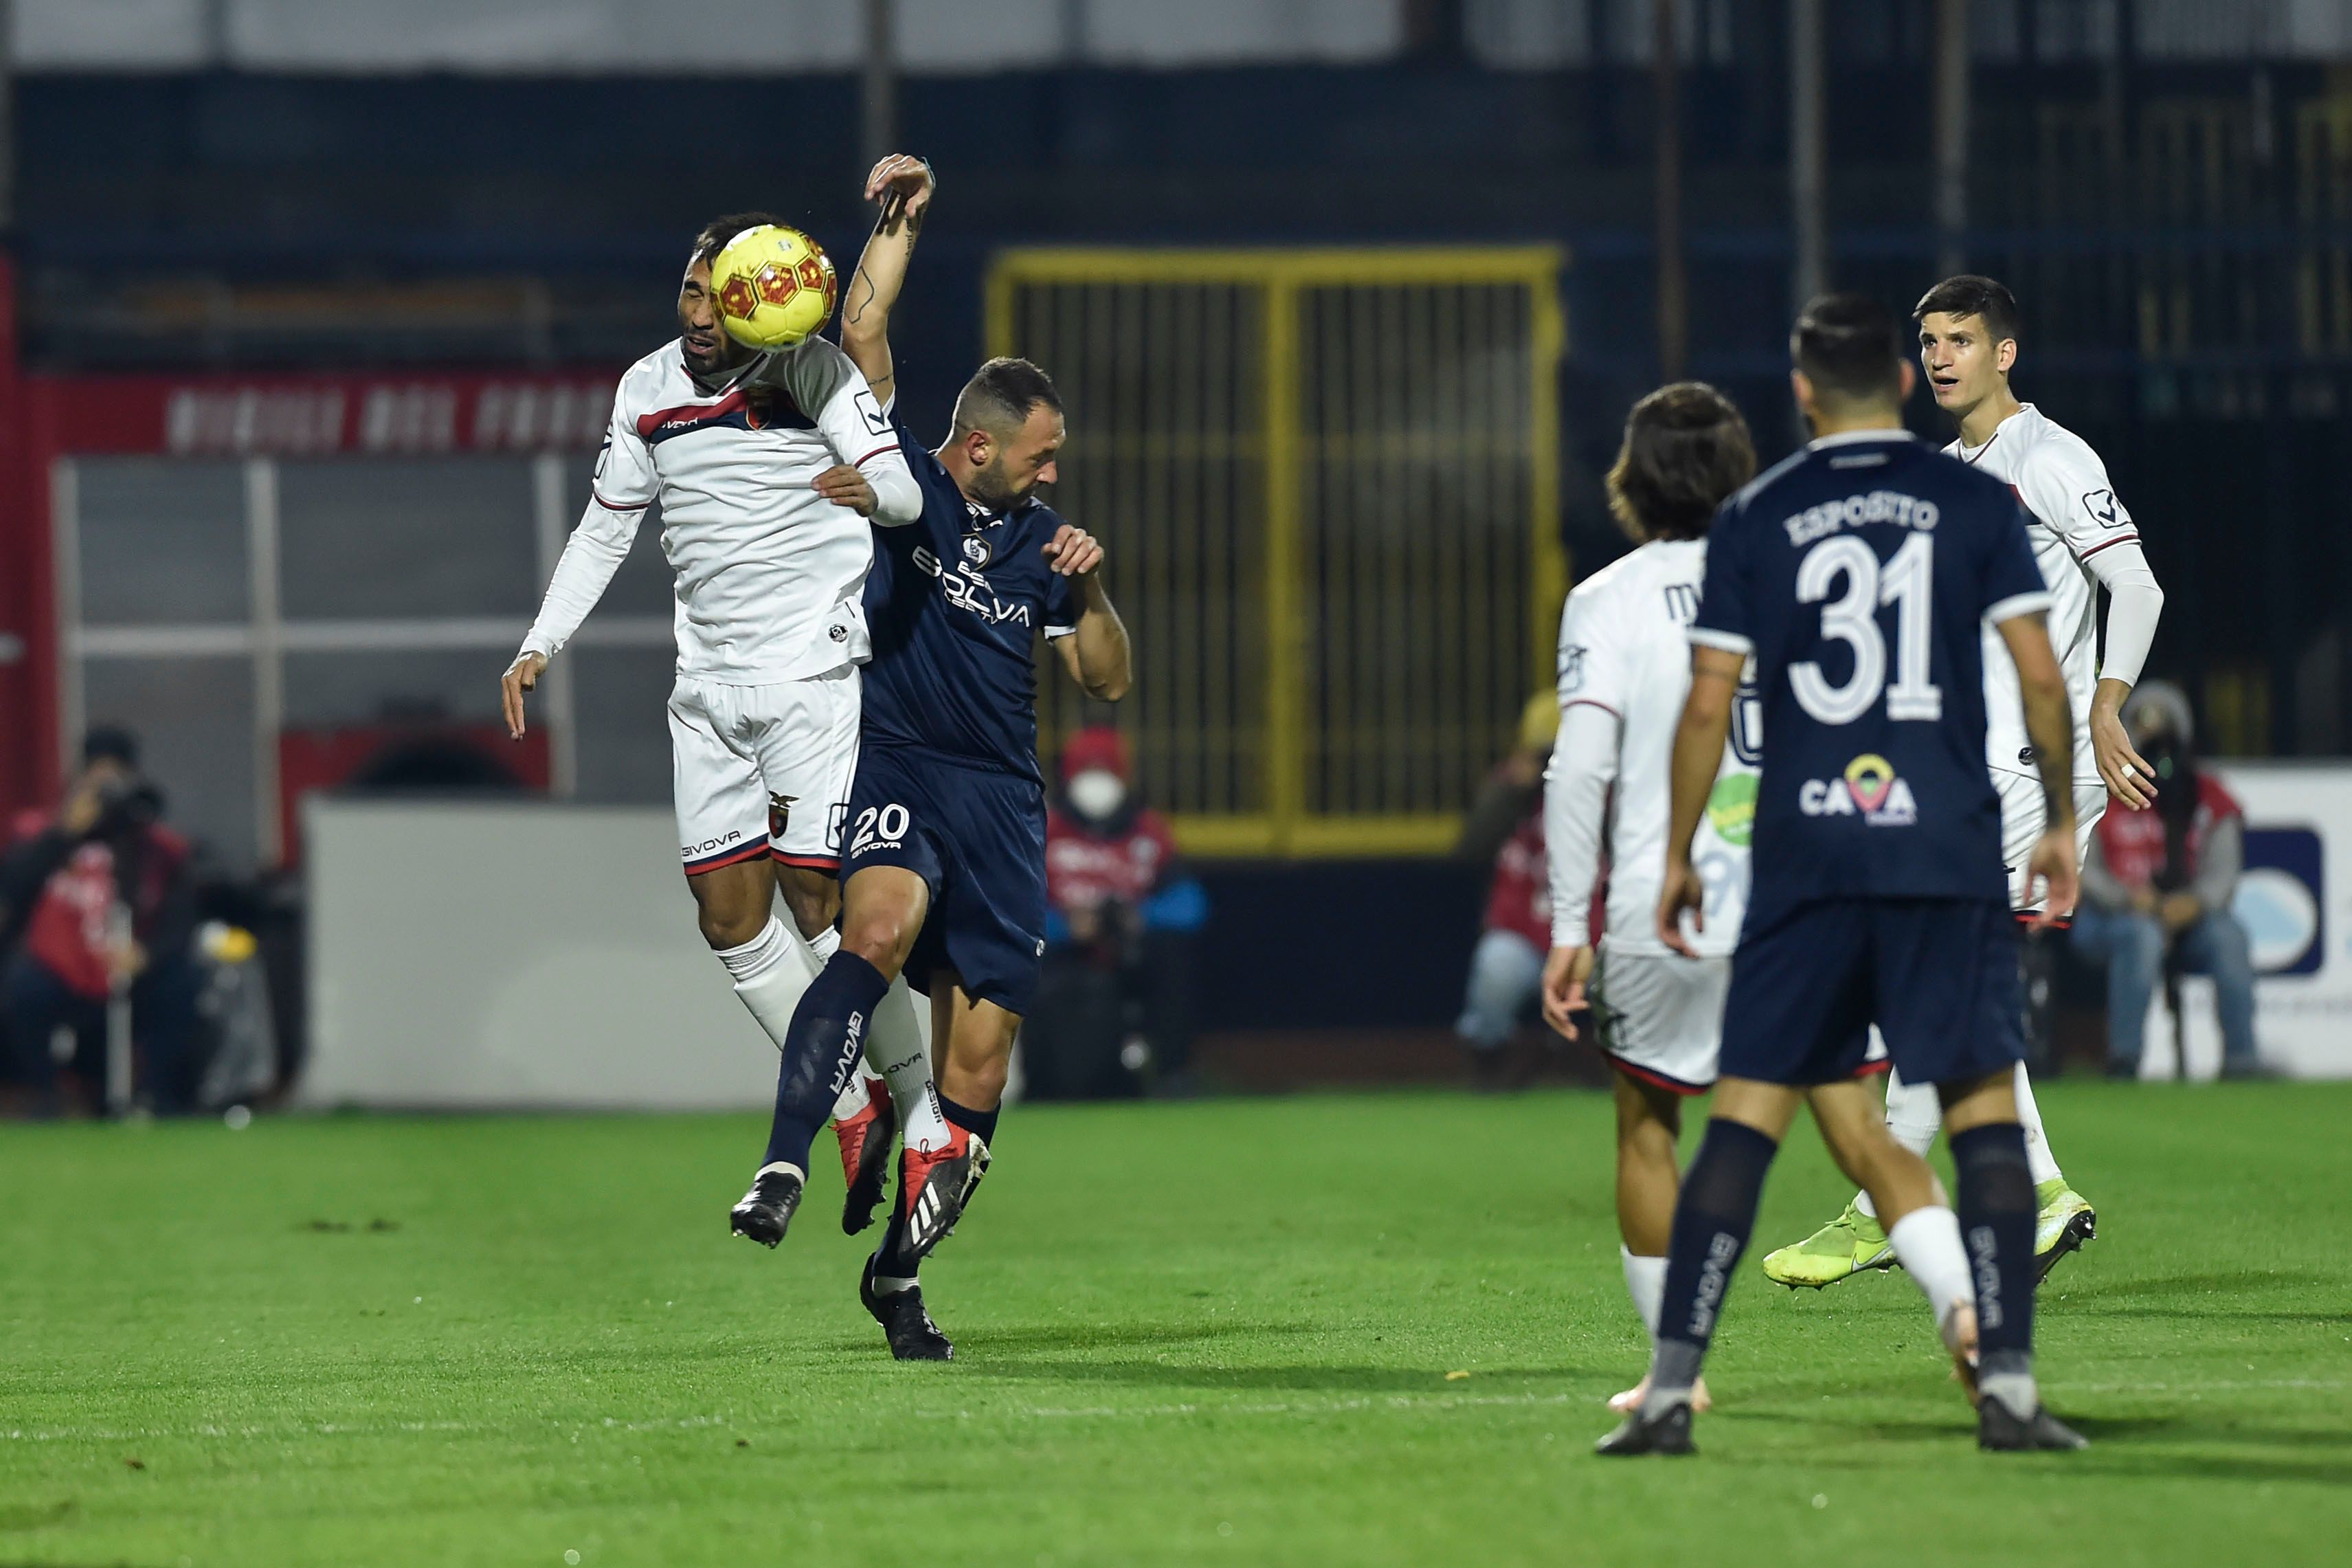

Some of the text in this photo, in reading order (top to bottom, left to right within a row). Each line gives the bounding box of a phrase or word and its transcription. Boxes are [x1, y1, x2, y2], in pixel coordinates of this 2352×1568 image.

[1784, 490, 1939, 547] ESPOSITO
[1787, 530, 1943, 726] 31
[681, 829, 741, 857] GIVOVA
[850, 803, 910, 853] 20
[851, 841, 901, 860] GIVOVA
[829, 1010, 864, 1095] GIVOVA
